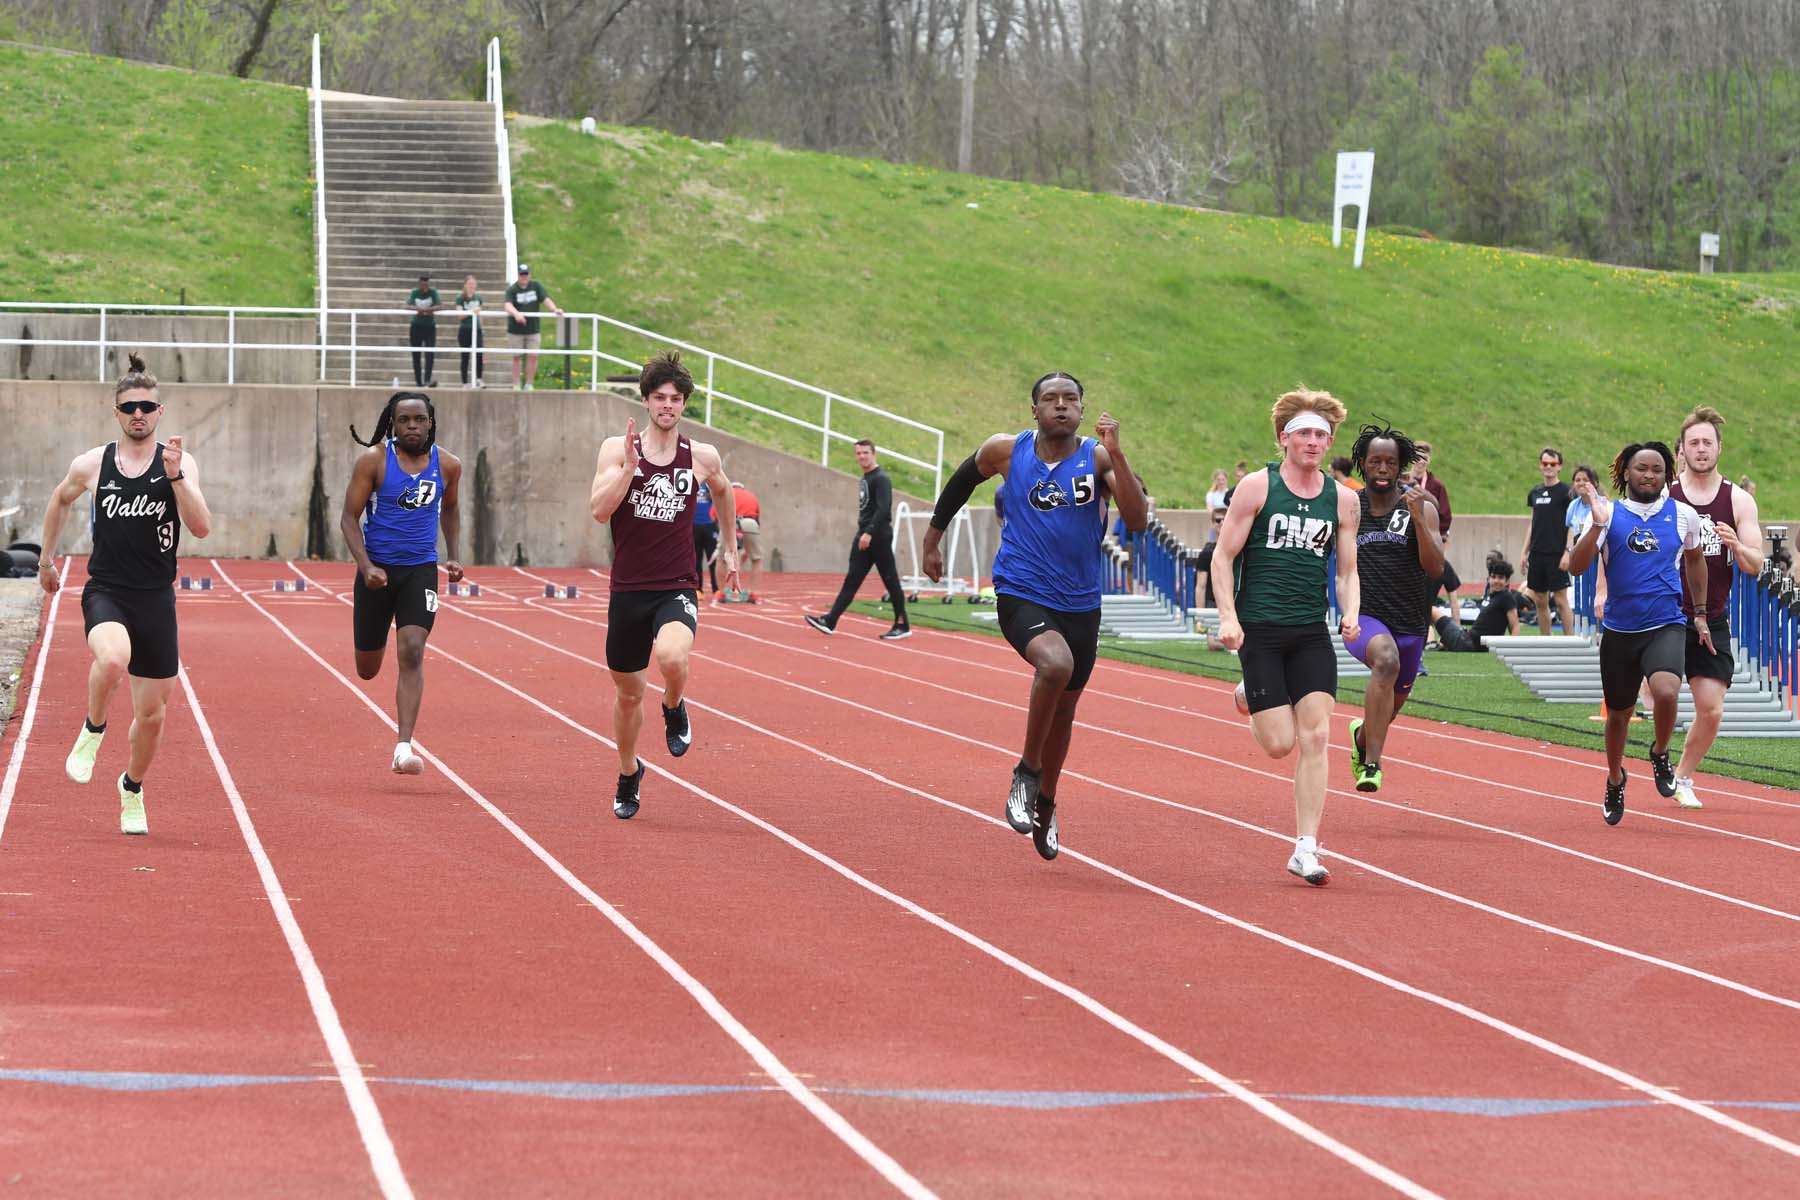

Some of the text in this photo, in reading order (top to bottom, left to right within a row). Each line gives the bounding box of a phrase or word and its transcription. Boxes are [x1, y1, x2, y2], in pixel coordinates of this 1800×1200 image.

[420, 481, 433, 503] 7
[675, 469, 688, 493] 6
[1074, 475, 1092, 504] 5
[102, 494, 166, 520] Valley
[631, 491, 685, 510] EVANGEL
[636, 504, 675, 520] VALOR
[1389, 510, 1410, 532] 3
[159, 524, 171, 550] 8
[1312, 523, 1328, 549] 4
[427, 591, 435, 611] 7
